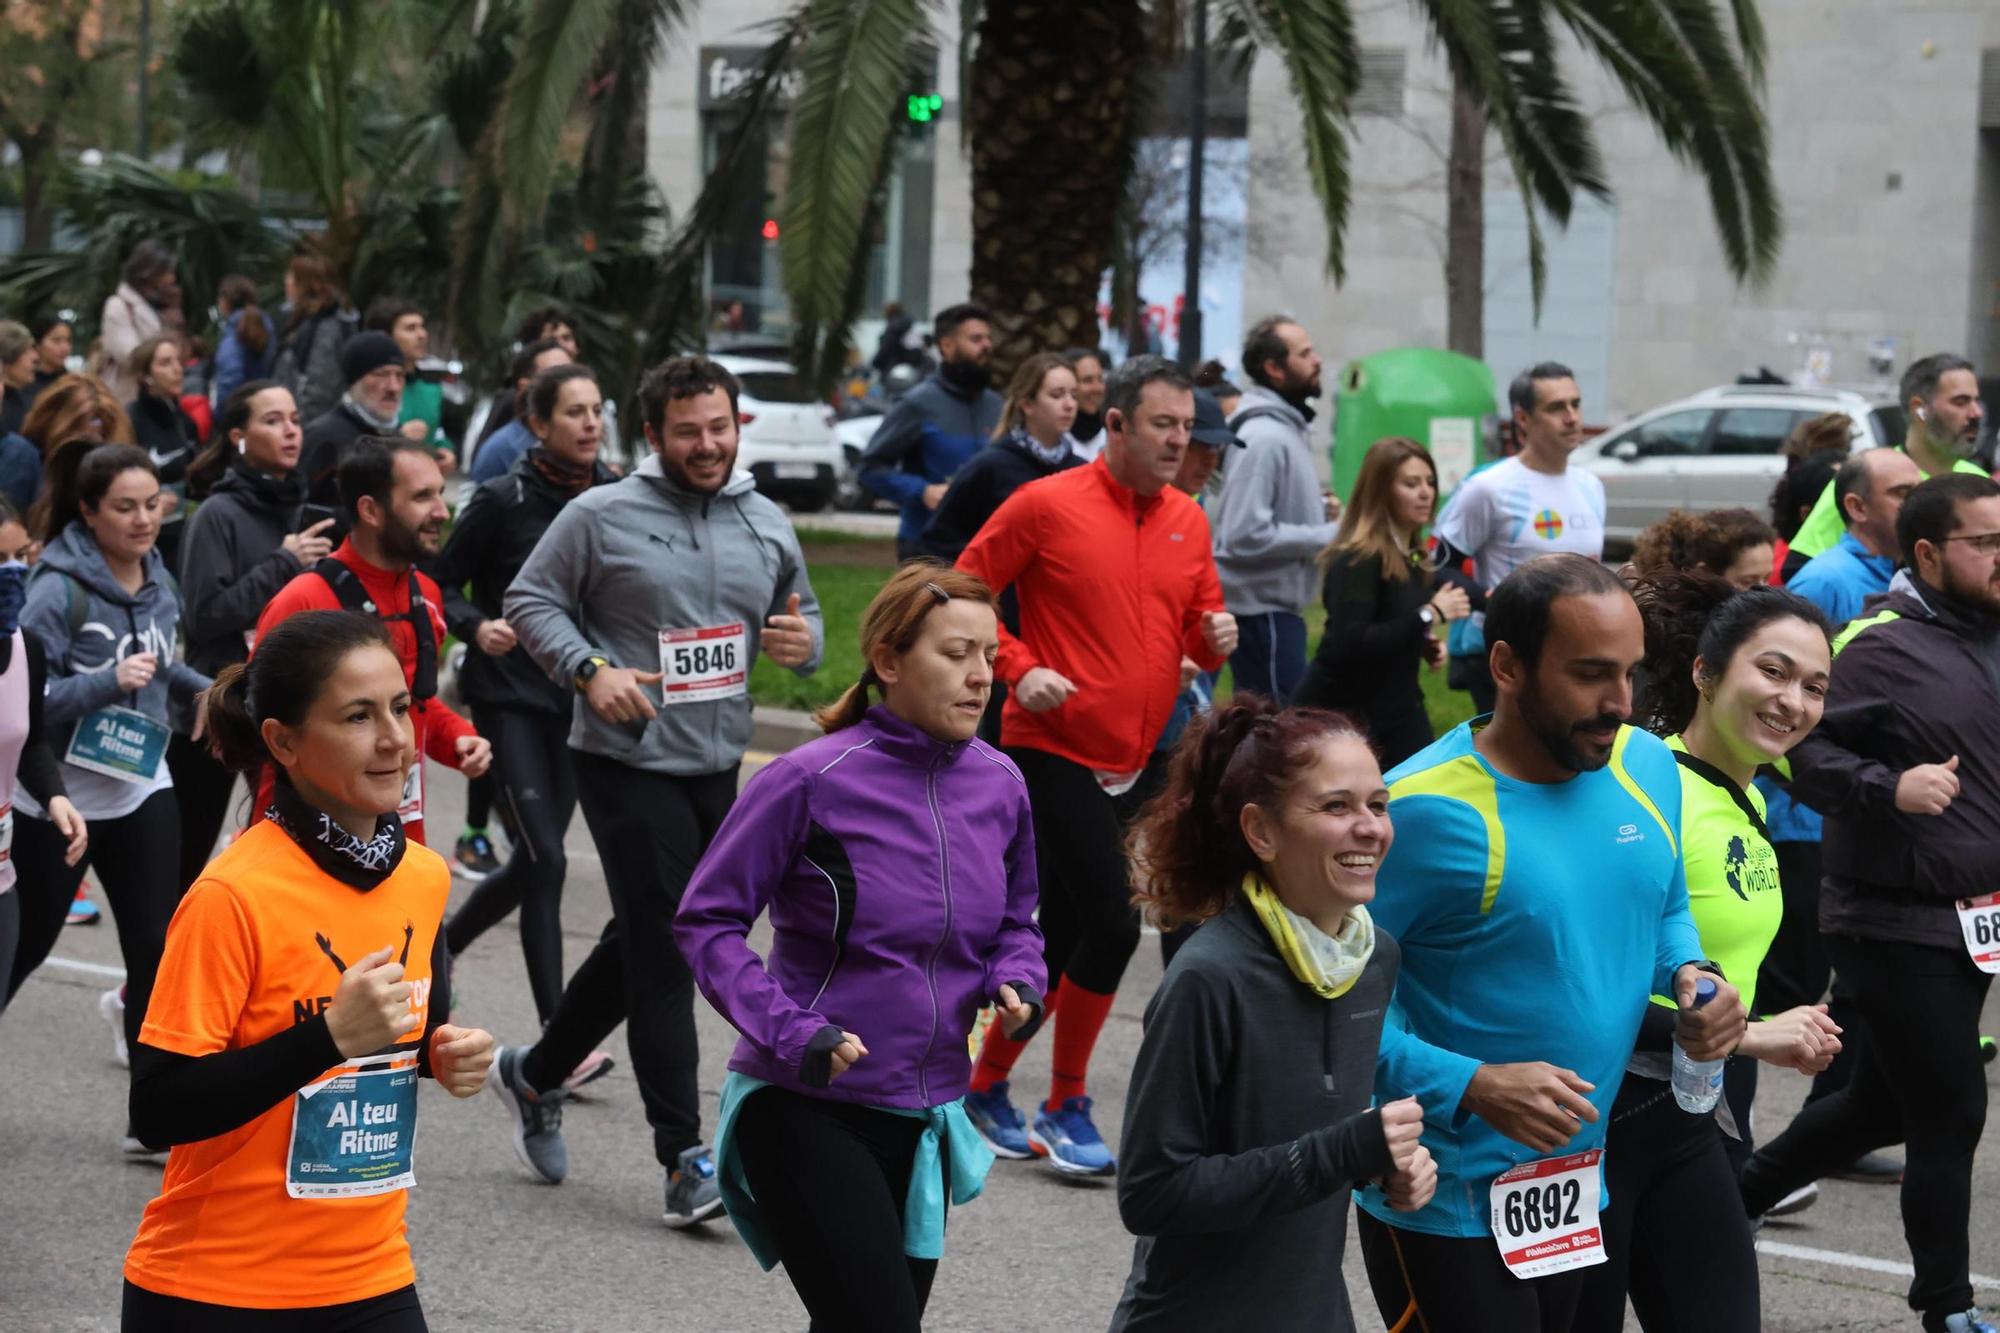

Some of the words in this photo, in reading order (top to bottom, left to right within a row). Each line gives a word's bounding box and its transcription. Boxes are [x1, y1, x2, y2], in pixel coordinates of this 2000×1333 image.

[674, 642, 735, 675] 5846
[96, 718, 117, 736] Al
[117, 725, 147, 746] teu
[99, 735, 145, 761] Ritme
[326, 1100, 358, 1128] Al
[362, 1102, 398, 1125] teu
[340, 1129, 399, 1155] Ritme
[1504, 1178, 1581, 1238] 6892
